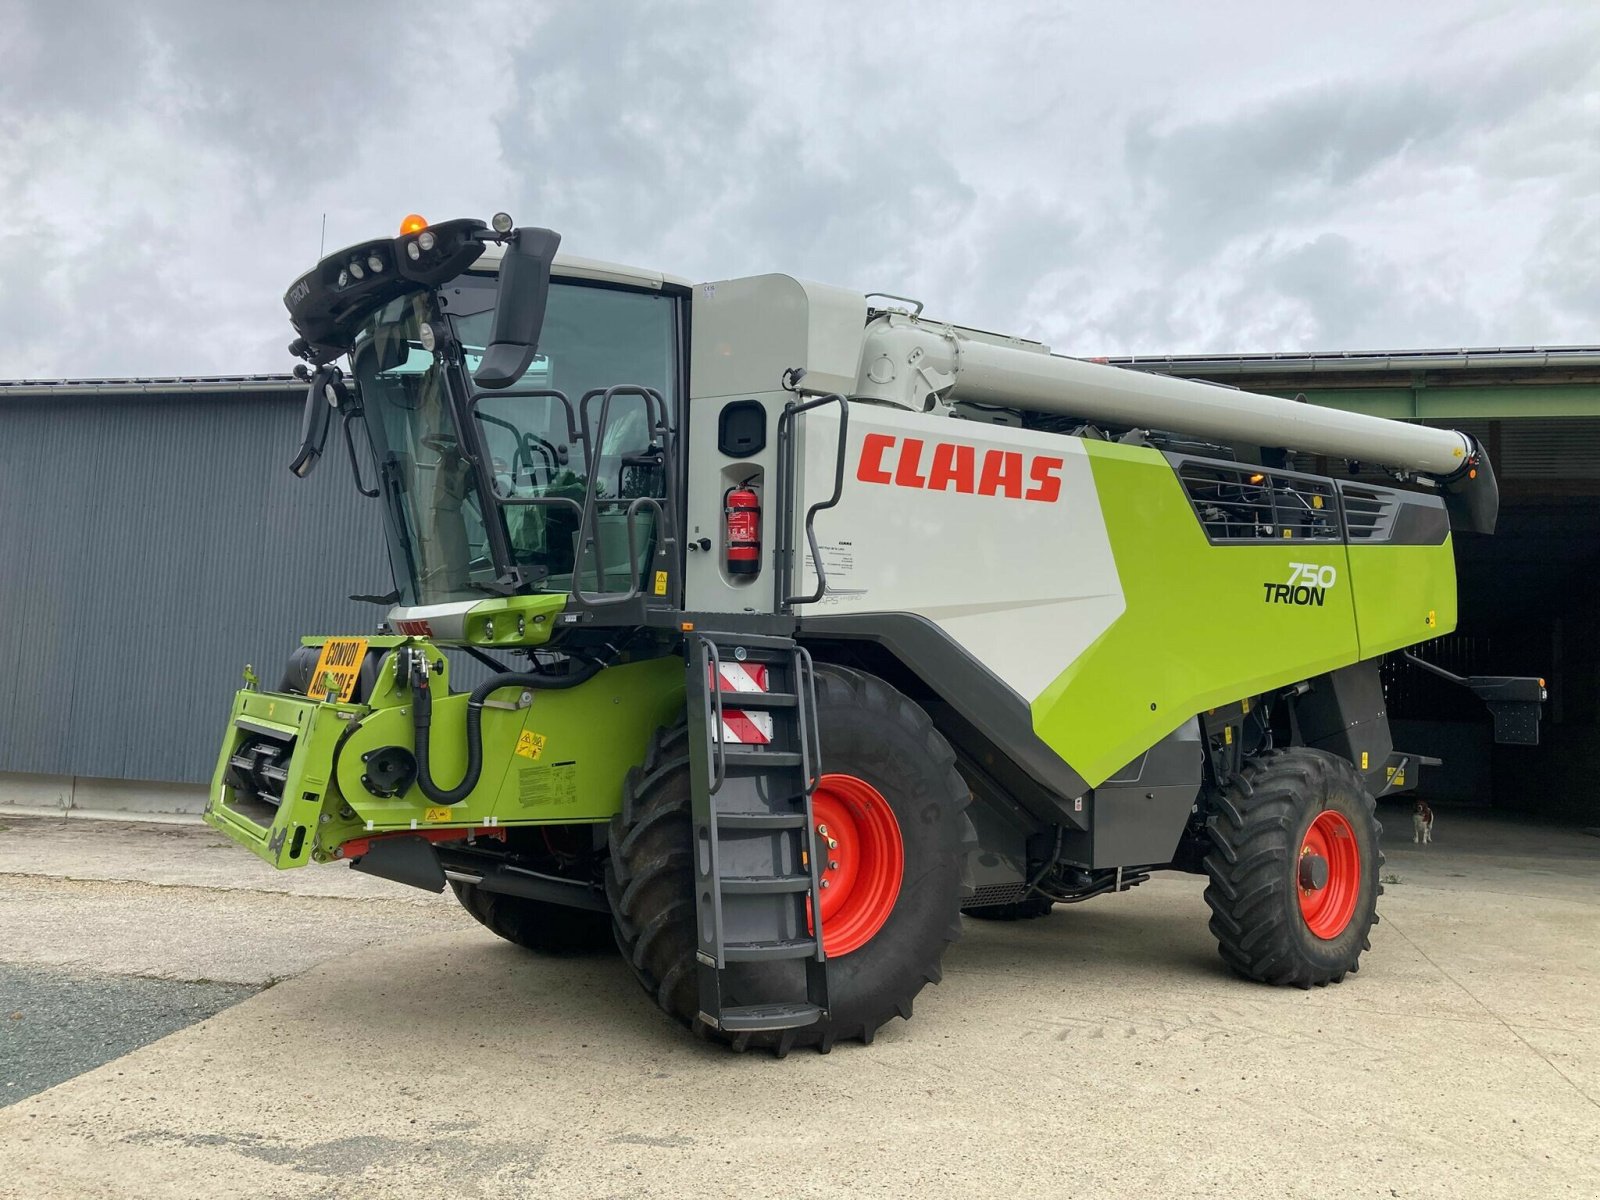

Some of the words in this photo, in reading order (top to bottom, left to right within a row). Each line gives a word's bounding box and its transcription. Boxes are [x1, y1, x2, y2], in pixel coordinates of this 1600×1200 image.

[856, 433, 1064, 503] CLAAS
[1286, 562, 1336, 589] 750
[1263, 583, 1326, 607] TRION
[325, 642, 360, 667] CONVOI
[311, 671, 355, 699] AGRCOLE
